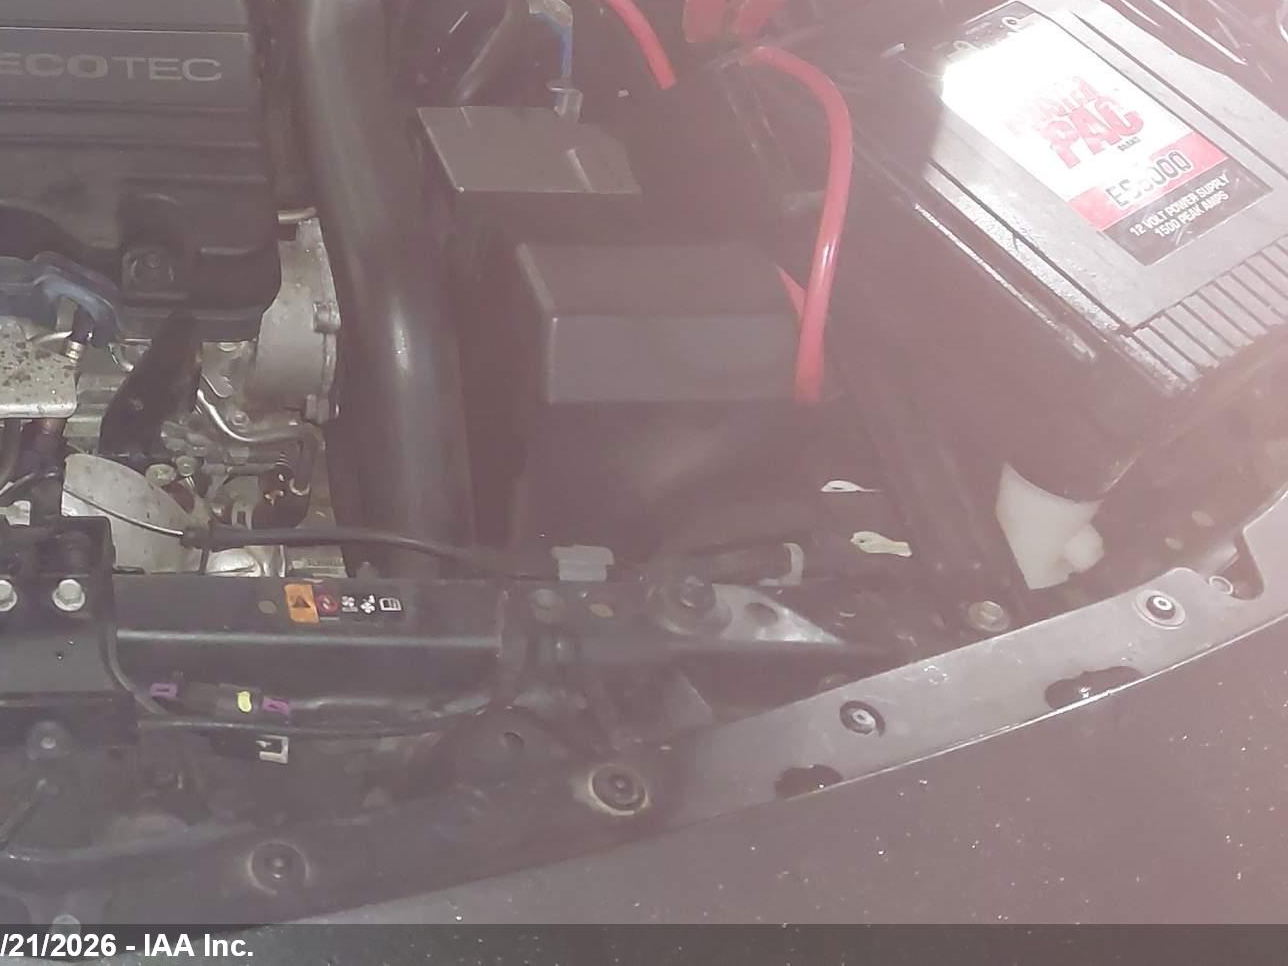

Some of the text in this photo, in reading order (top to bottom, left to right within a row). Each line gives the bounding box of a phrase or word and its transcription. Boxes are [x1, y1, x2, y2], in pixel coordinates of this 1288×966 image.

[1129, 172, 1231, 237] 12 VOLT POWER SUPPLY
[1178, 202, 1207, 225] PEAK
[1200, 190, 1230, 212] AMPS
